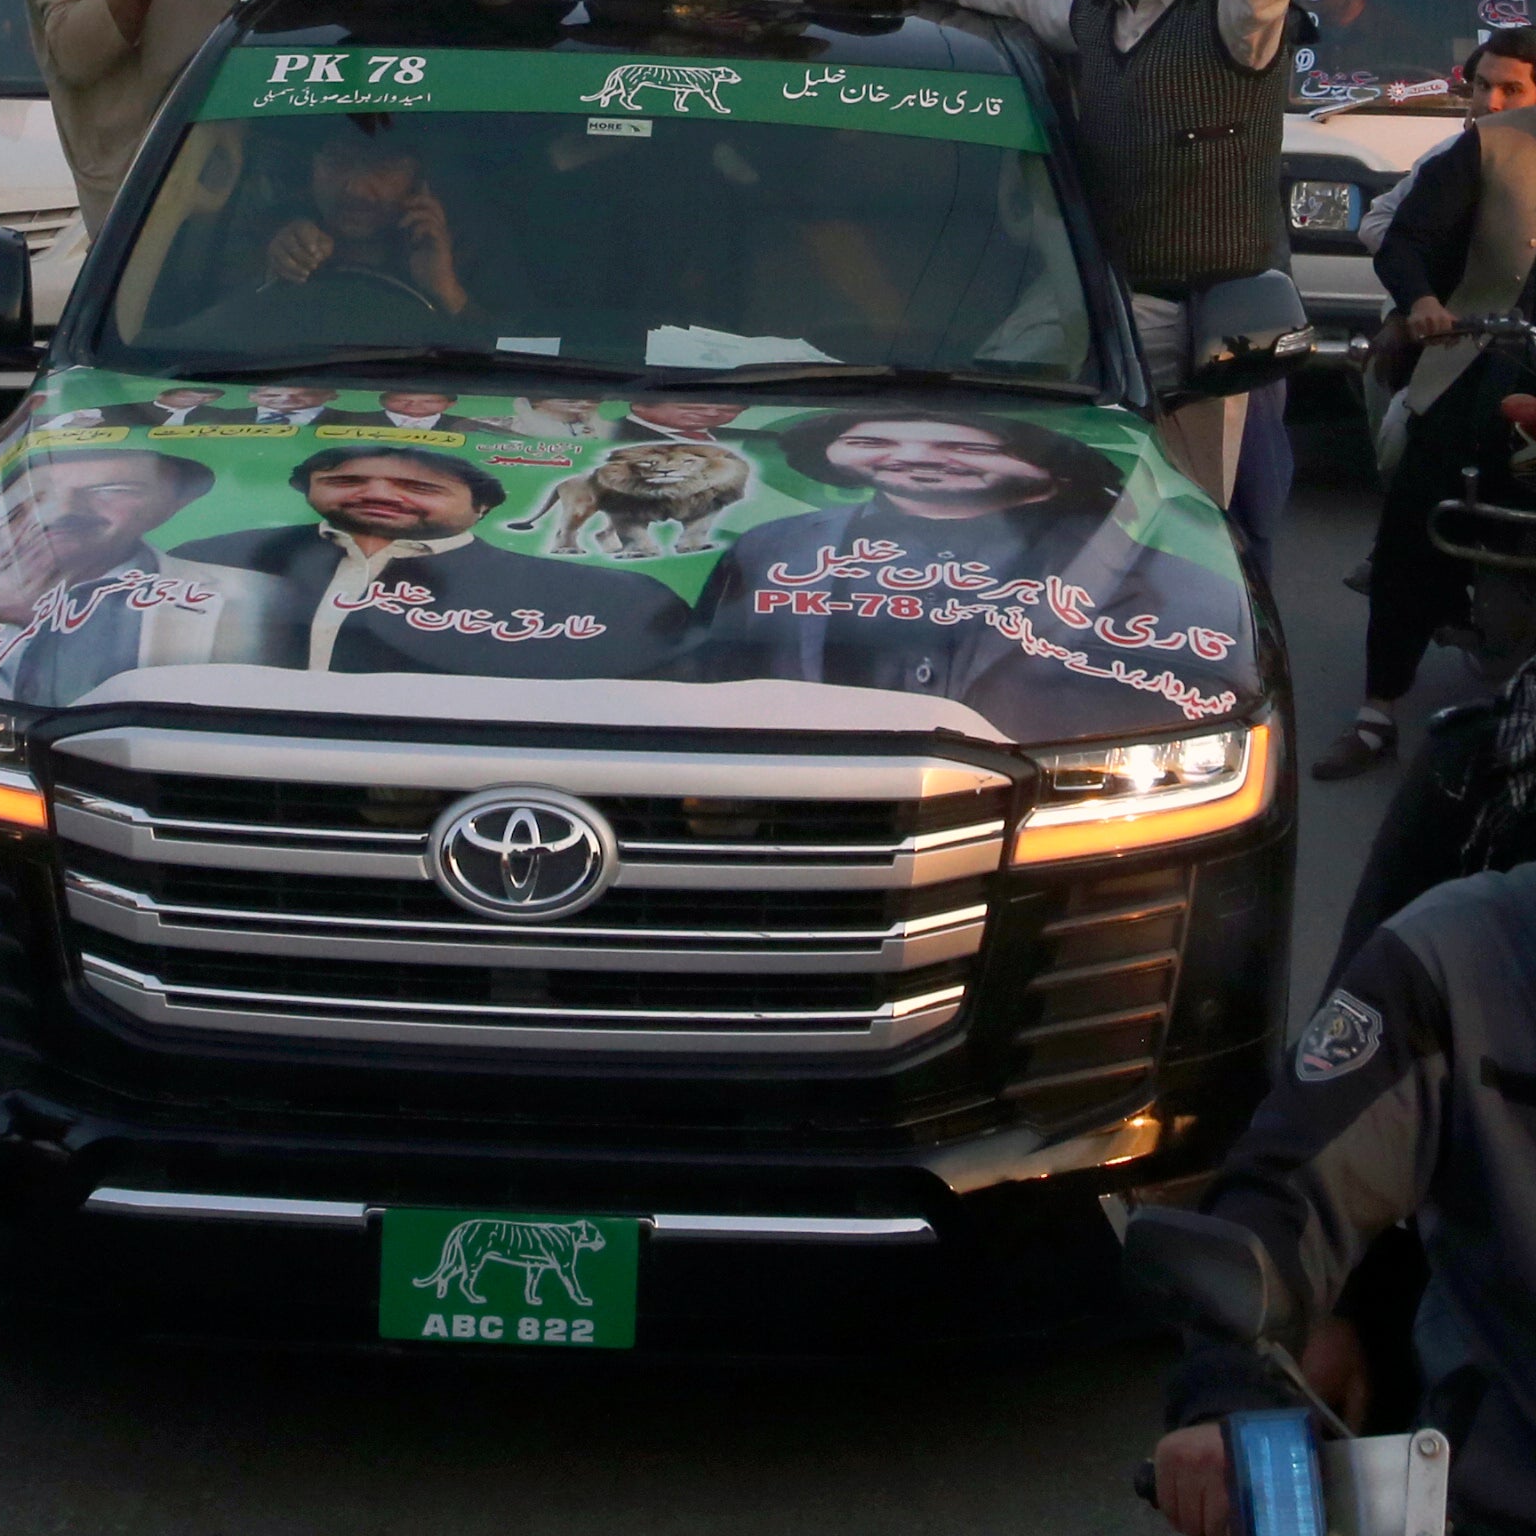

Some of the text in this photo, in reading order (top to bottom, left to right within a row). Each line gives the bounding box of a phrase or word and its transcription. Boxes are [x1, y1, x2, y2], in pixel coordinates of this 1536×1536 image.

[266, 53, 428, 85] PK 78
[782, 66, 847, 100] خلیل
[839, 83, 891, 104] خان
[942, 90, 1004, 116] قاری
[588, 121, 624, 133] MORE
[766, 537, 907, 588] خلیل
[876, 557, 997, 591] خان
[126, 578, 217, 611] حاجی
[754, 590, 924, 620] PK-78
[332, 581, 607, 642] طارق خان خلیل
[1094, 613, 1237, 661] قاری
[421, 1313, 595, 1343] ABC 822
